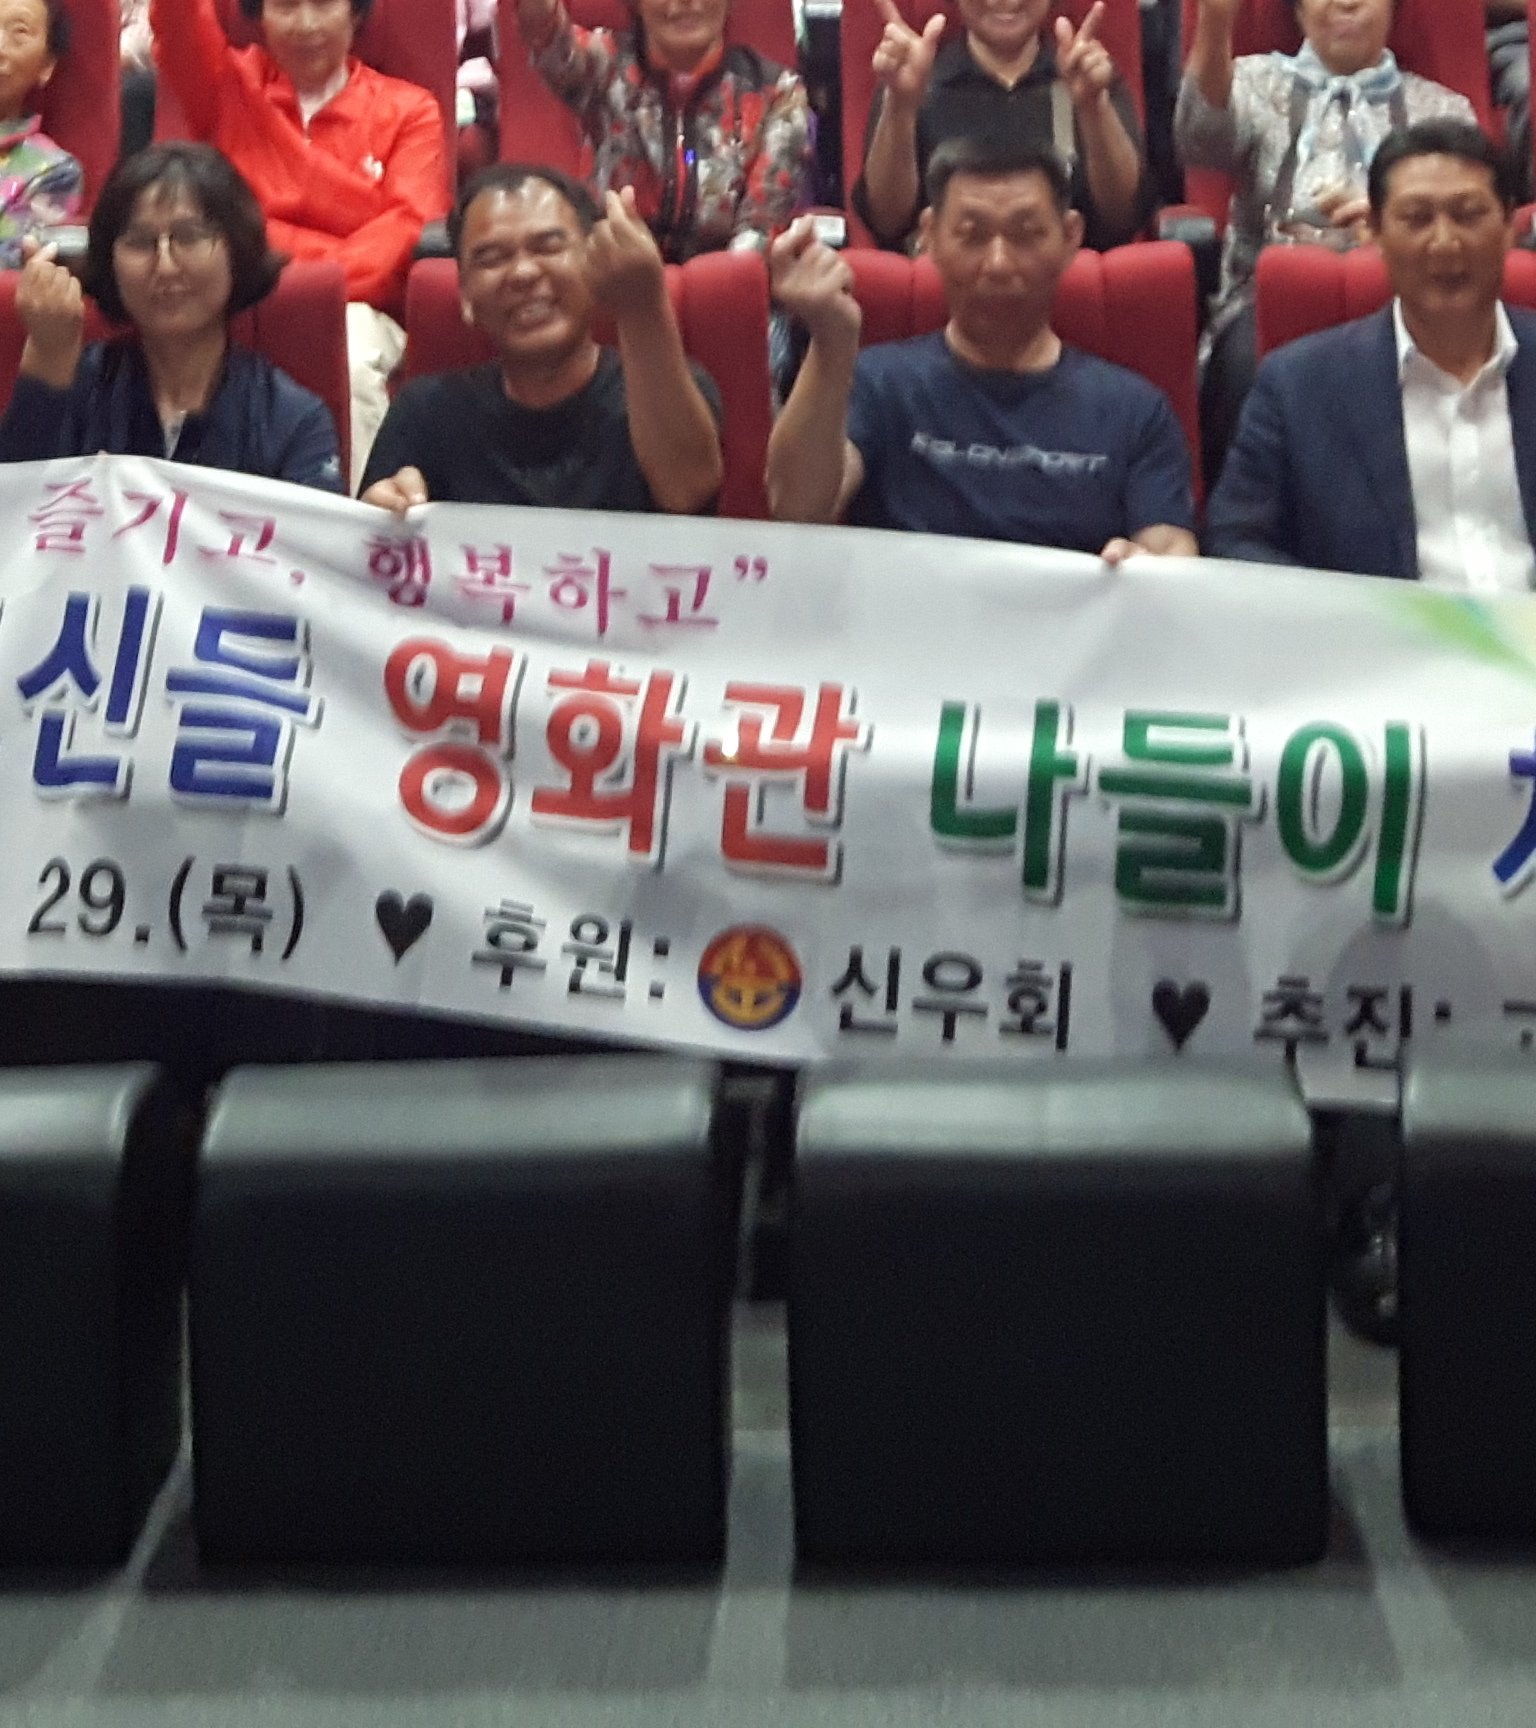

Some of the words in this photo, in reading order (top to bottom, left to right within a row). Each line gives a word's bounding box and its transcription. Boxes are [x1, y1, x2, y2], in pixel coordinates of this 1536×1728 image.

[28, 478, 306, 587] 즐기고,
[382, 633, 870, 880] 영화관
[928, 696, 1420, 924] 나들이
[471, 898, 670, 1000] 후원:
[831, 944, 1072, 1051] 신우회
